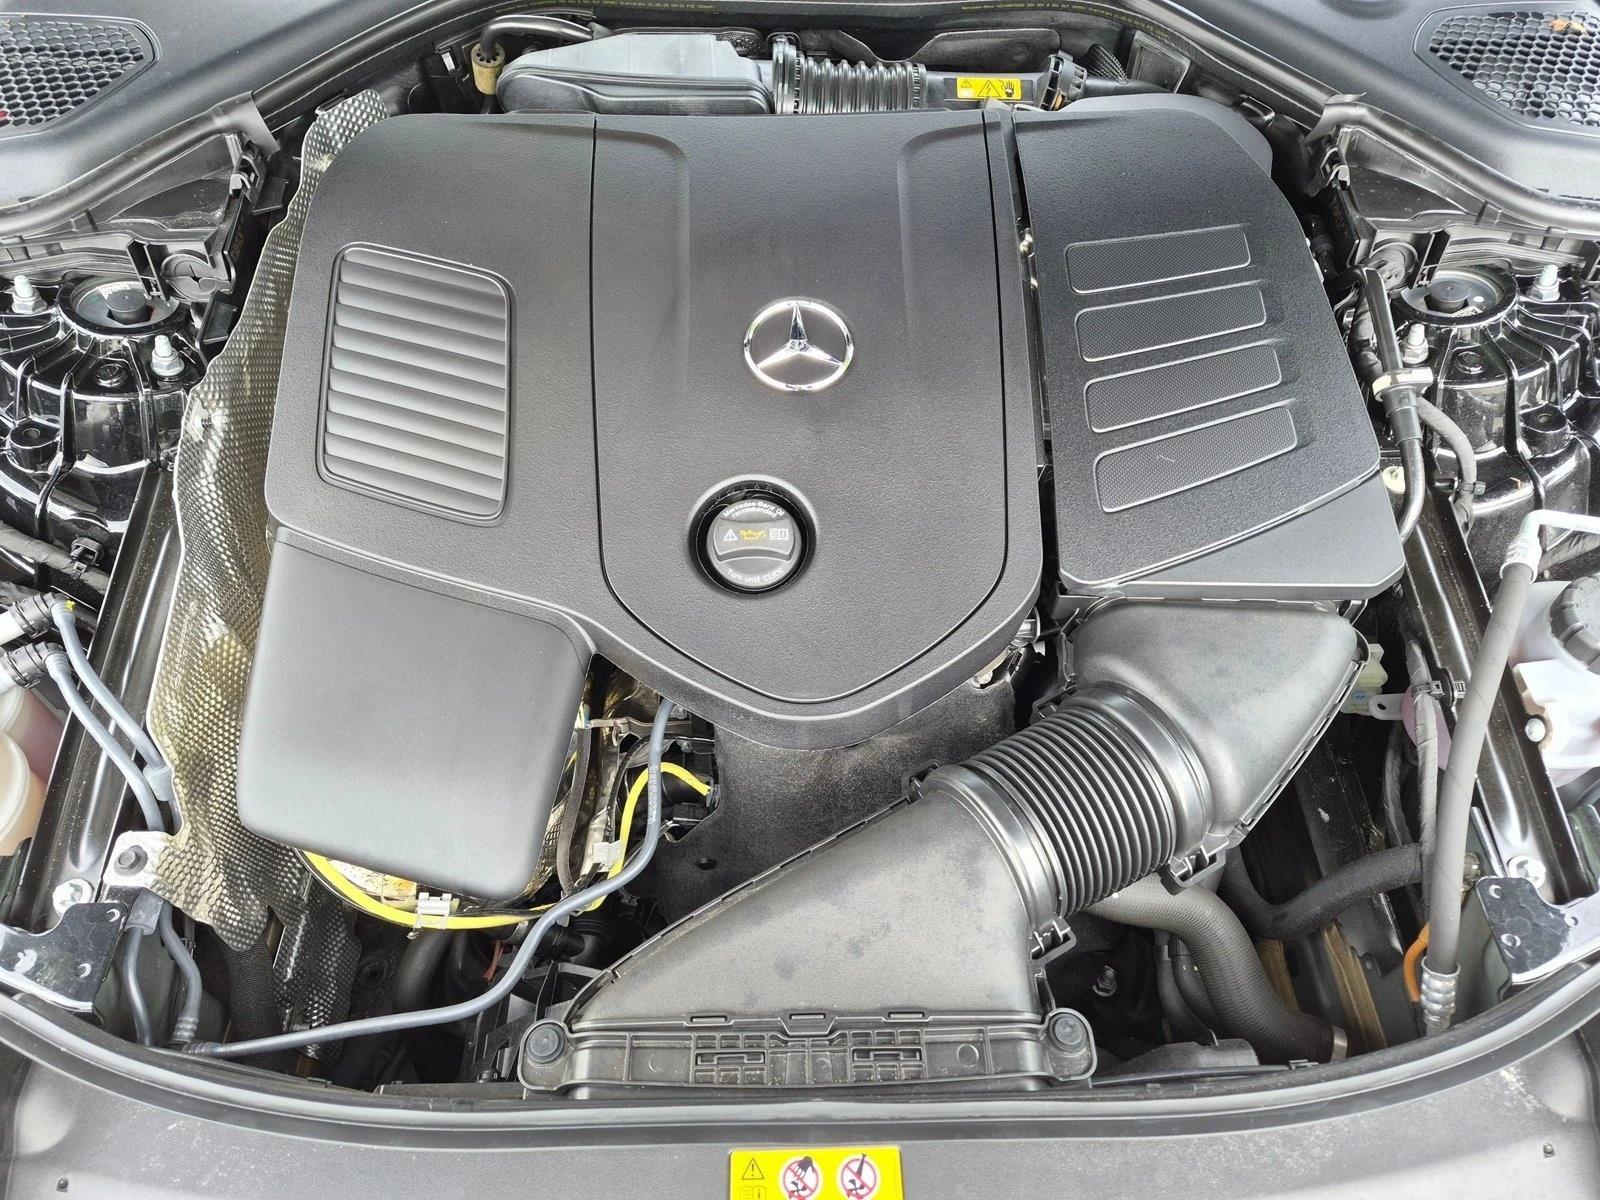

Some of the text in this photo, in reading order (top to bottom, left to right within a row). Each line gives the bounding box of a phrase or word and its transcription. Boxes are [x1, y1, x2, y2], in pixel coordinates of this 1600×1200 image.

[722, 501, 775, 517] Mercedes-Benz
[731, 507, 777, 518] recommended
[727, 567, 785, 583] Turn until CLICK
